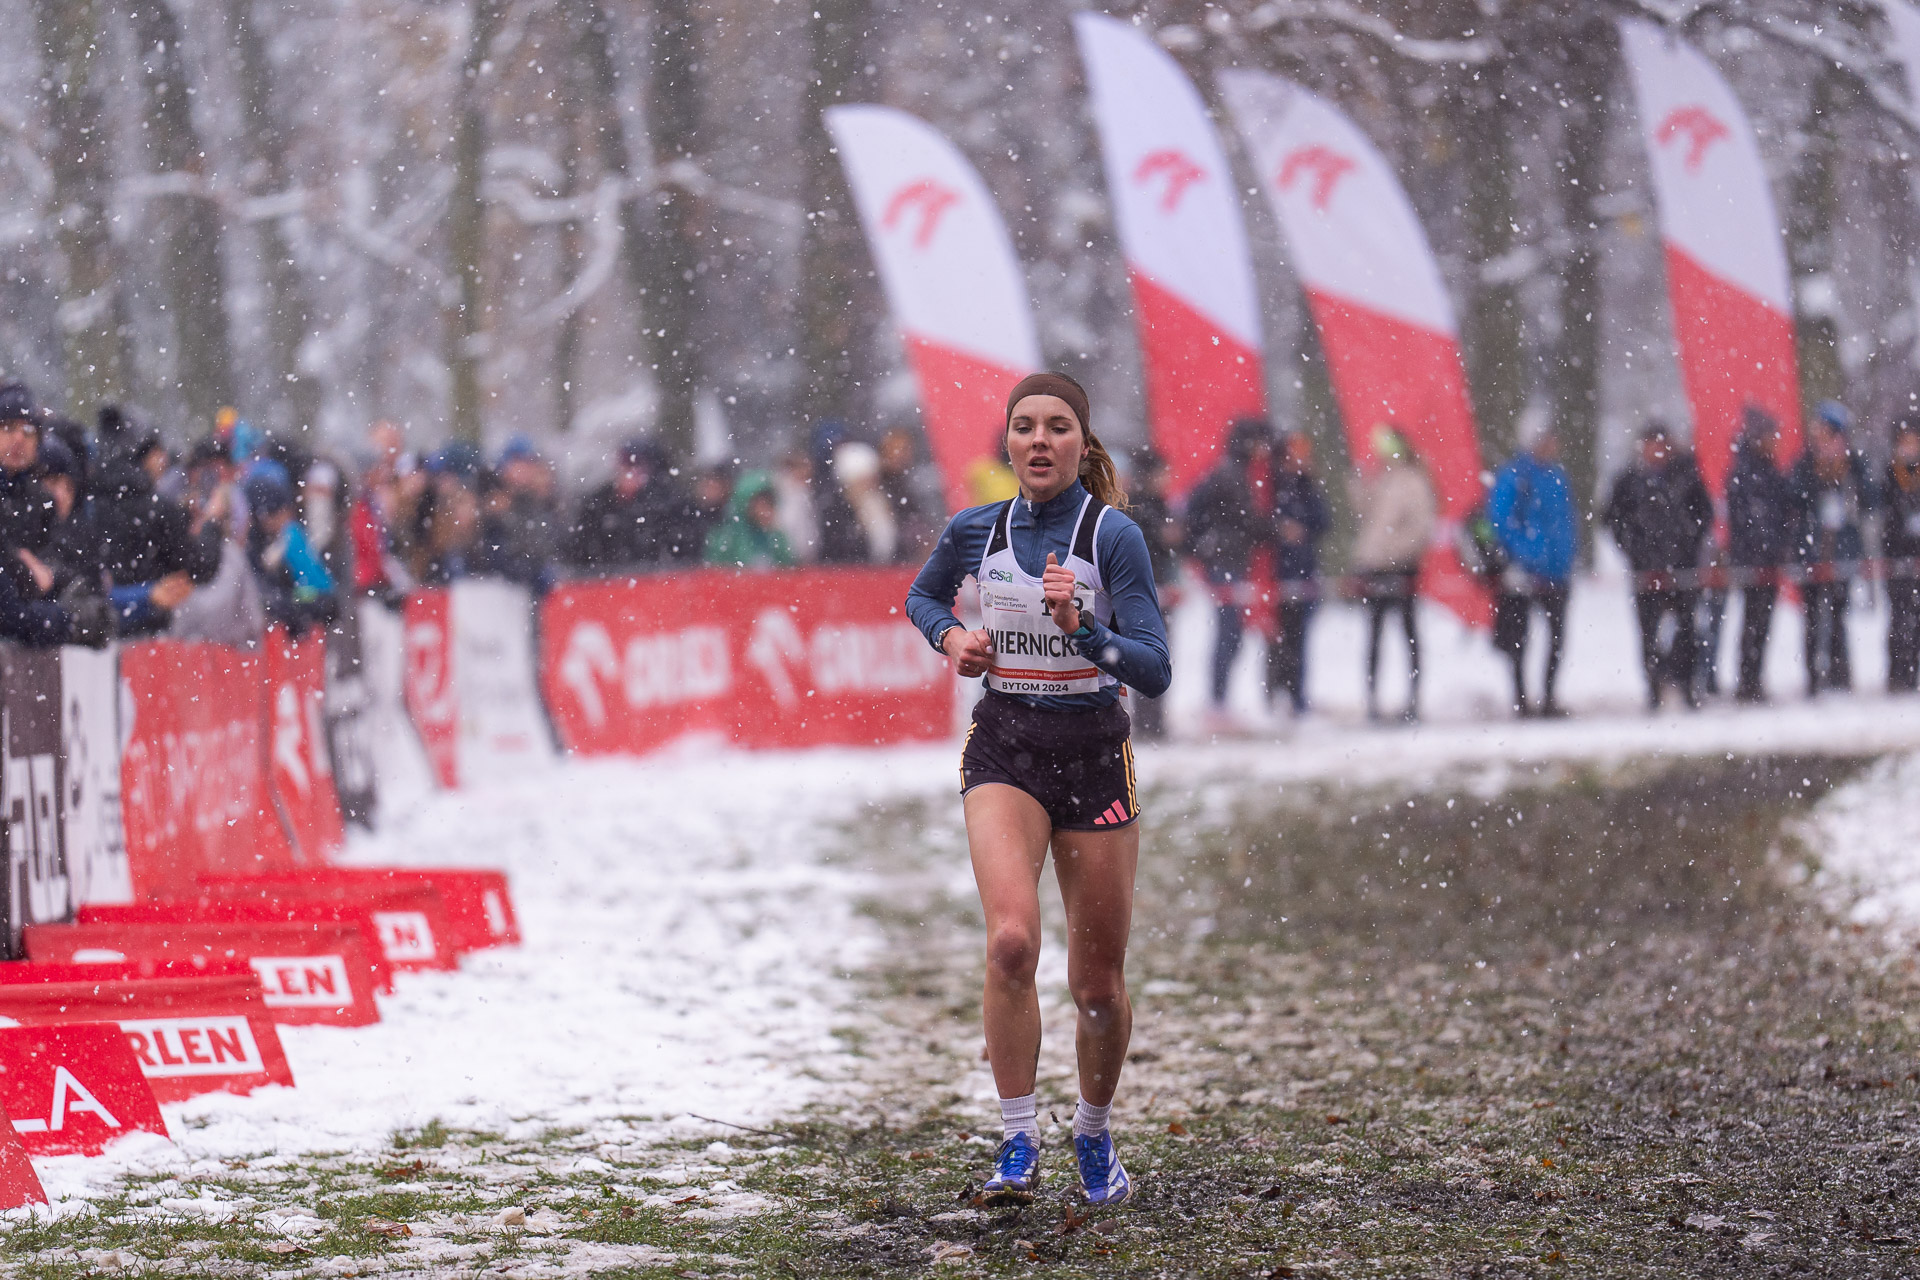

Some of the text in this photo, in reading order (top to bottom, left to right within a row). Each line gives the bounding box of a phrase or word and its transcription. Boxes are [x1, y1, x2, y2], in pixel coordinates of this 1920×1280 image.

[983, 625, 1081, 658] WIERNICK
[1002, 682, 1069, 692] BYTOM 2024
[121, 1027, 248, 1068] RLEN
